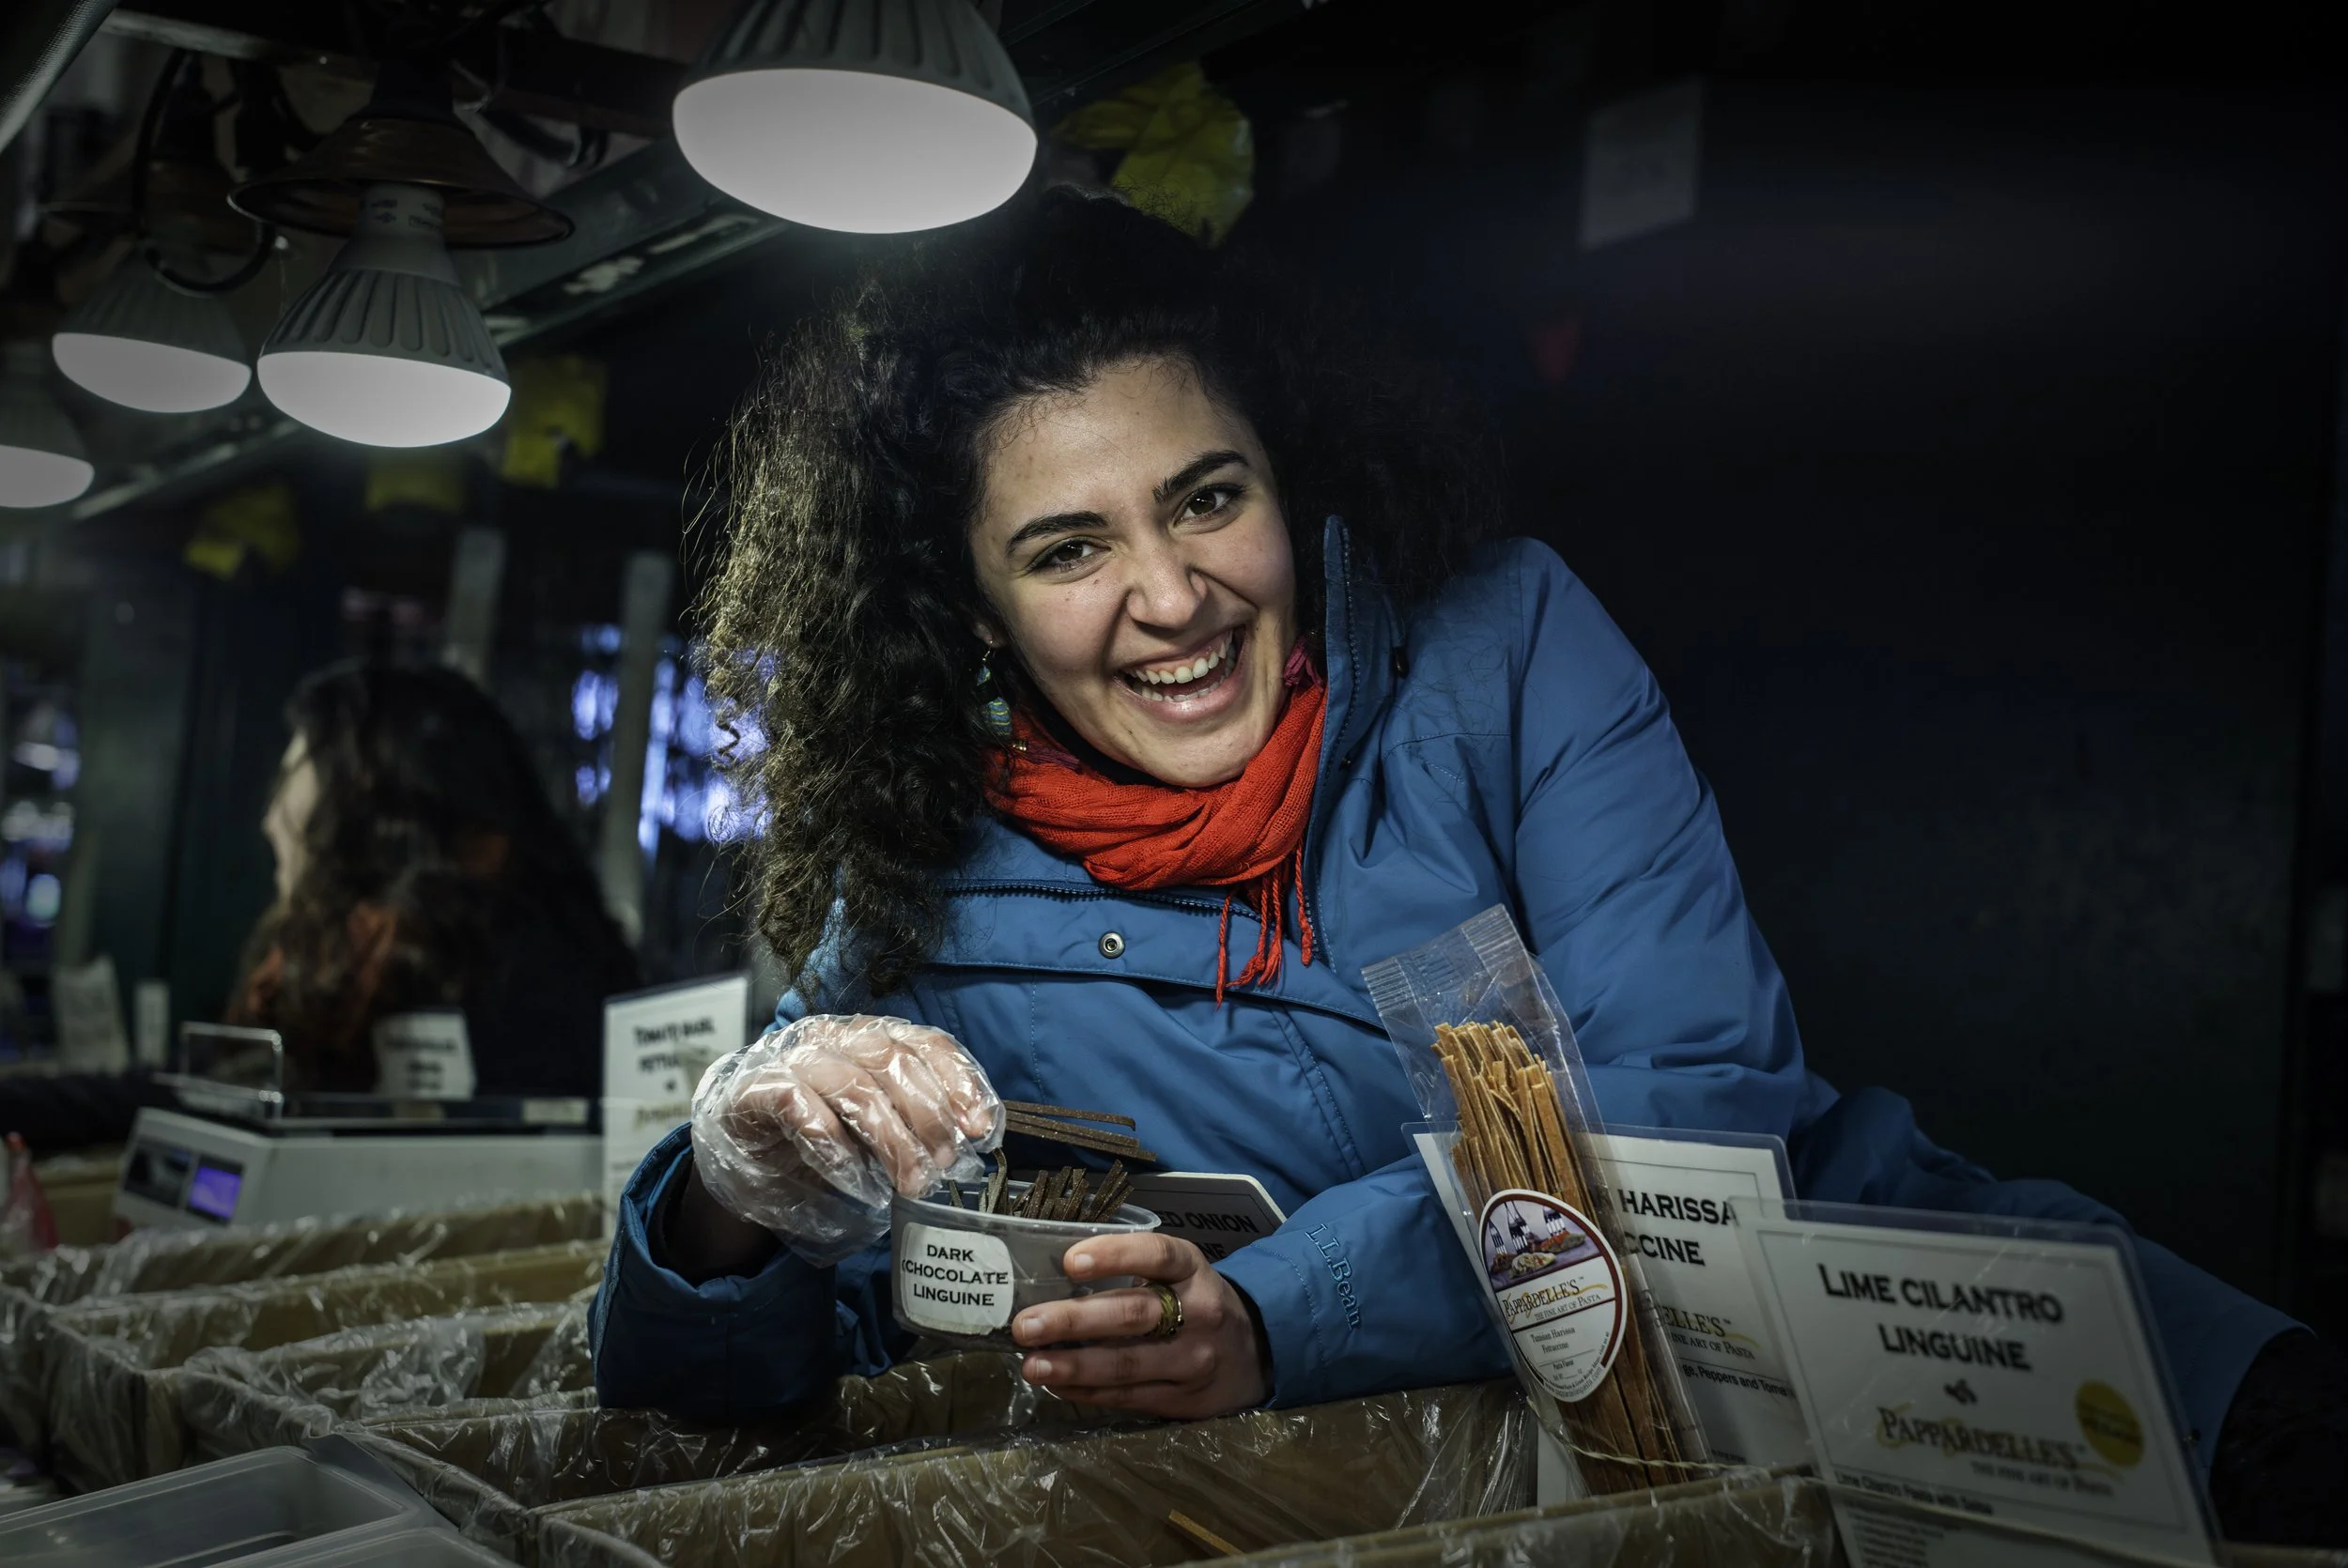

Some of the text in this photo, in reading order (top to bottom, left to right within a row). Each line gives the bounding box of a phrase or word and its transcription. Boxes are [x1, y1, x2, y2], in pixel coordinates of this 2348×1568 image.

[1153, 1210, 1259, 1233] ED ONION
[1618, 1189, 1739, 1227] HARISSA
[926, 1244, 975, 1263] DARK
[1624, 1231, 1706, 1267] CCINE
[905, 1259, 1009, 1284] CHOCOLATE
[913, 1284, 995, 1306] LINGUINE
[1502, 1279, 1581, 1317] PAPPARDELLE'S
[1557, 1304, 1568, 1314] ART
[1568, 1300, 1577, 1310] OF
[1577, 1294, 1601, 1307] PASTA
[1816, 1263, 2064, 1324] LIME CILANTRO
[1657, 1306, 1726, 1338] ELLE'S
[1671, 1332, 1756, 1360] INE ART OF PASTA
[1877, 1322, 2033, 1373] LINGUINE
[1698, 1365, 1738, 1386] Peppers
[1739, 1376, 1759, 1391] and
